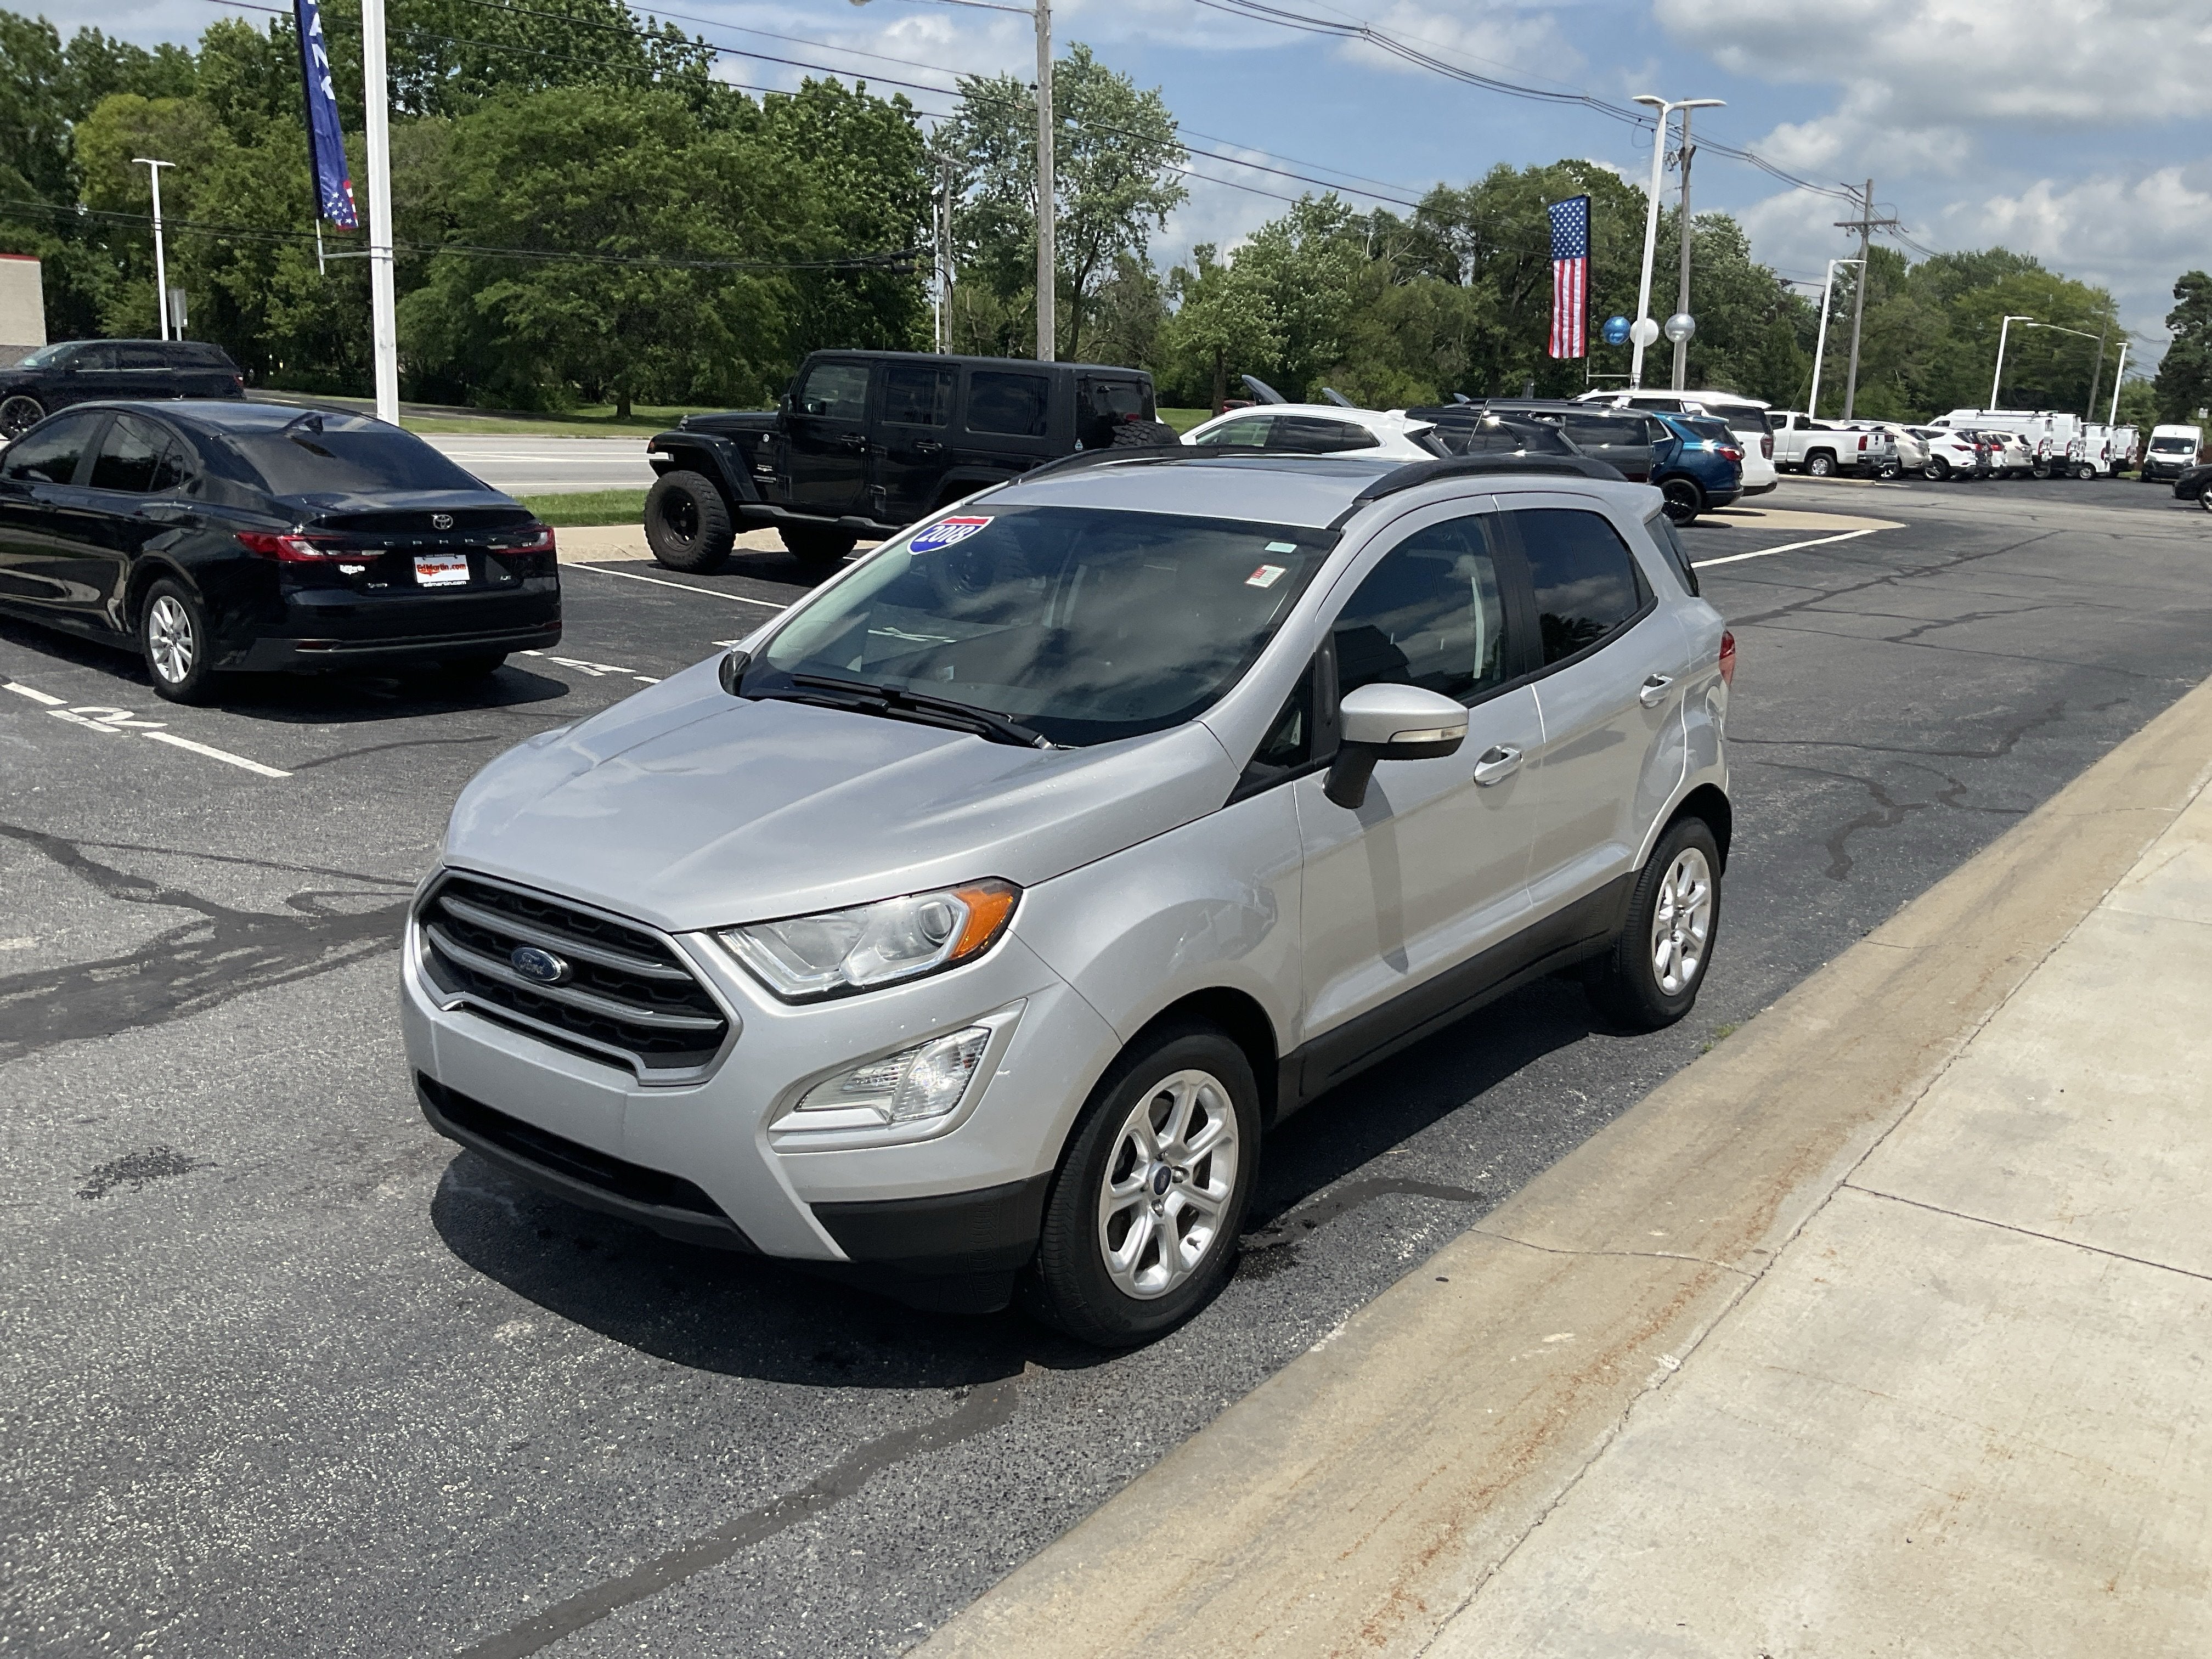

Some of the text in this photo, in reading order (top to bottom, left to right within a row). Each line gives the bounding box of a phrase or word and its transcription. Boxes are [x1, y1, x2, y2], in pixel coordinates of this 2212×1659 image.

[915, 525, 975, 543] 2018
[45, 706, 168, 733] R
[519, 952, 545, 975] Ford
